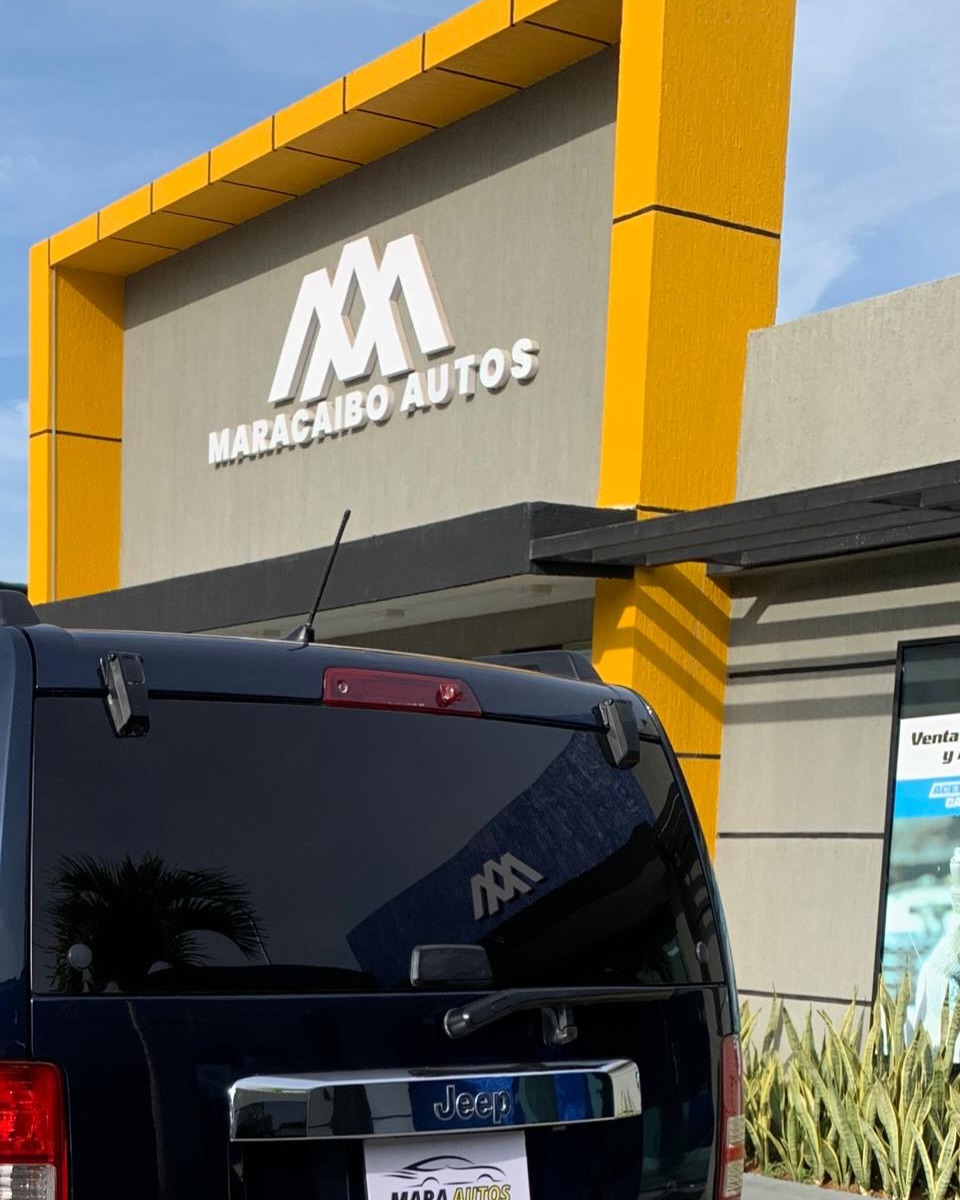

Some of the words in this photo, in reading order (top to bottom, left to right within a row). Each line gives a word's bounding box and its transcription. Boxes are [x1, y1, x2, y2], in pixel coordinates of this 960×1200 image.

[208, 384, 393, 464] MARACAIBO
[400, 338, 540, 412] AUTOS
[911, 730, 960, 746] Venta
[942, 750, 954, 765] y
[433, 1085, 513, 1124] Jeep
